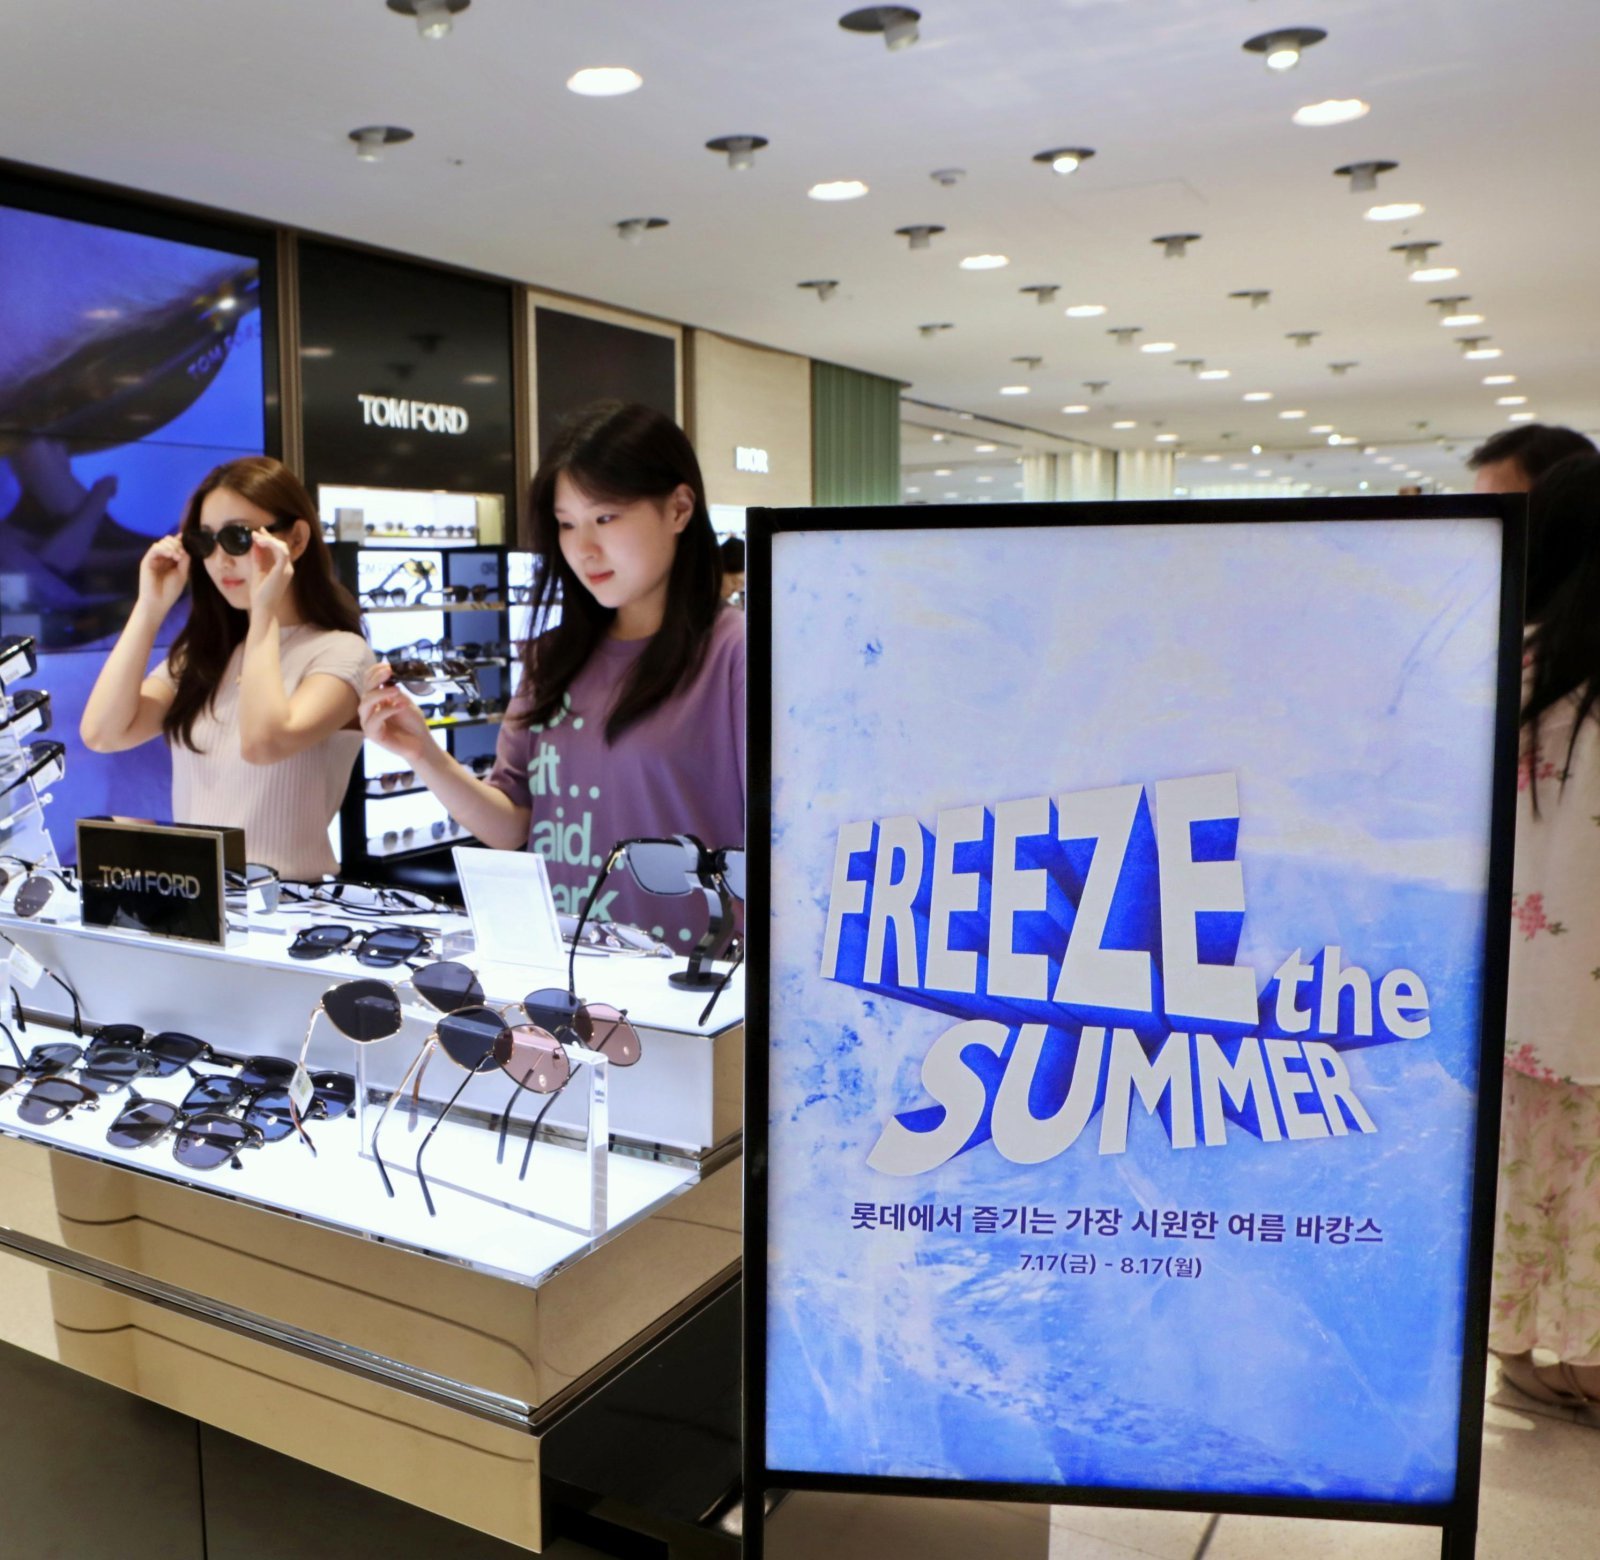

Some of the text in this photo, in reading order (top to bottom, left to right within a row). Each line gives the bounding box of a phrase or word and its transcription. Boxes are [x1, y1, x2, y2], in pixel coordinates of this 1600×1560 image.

[357, 393, 470, 435] TOM FORD
[98, 865, 201, 900] TOM FORD
[819, 772, 1432, 1040] FREEZE the
[865, 1019, 1378, 1177] SUMMER
[850, 1202, 1384, 1245] 롯데에서 즐기는 가장 시원한 여름 바캉스
[1020, 1253, 1097, 1275] 7.17(금)
[1119, 1256, 1203, 1279] 8.17(월)
